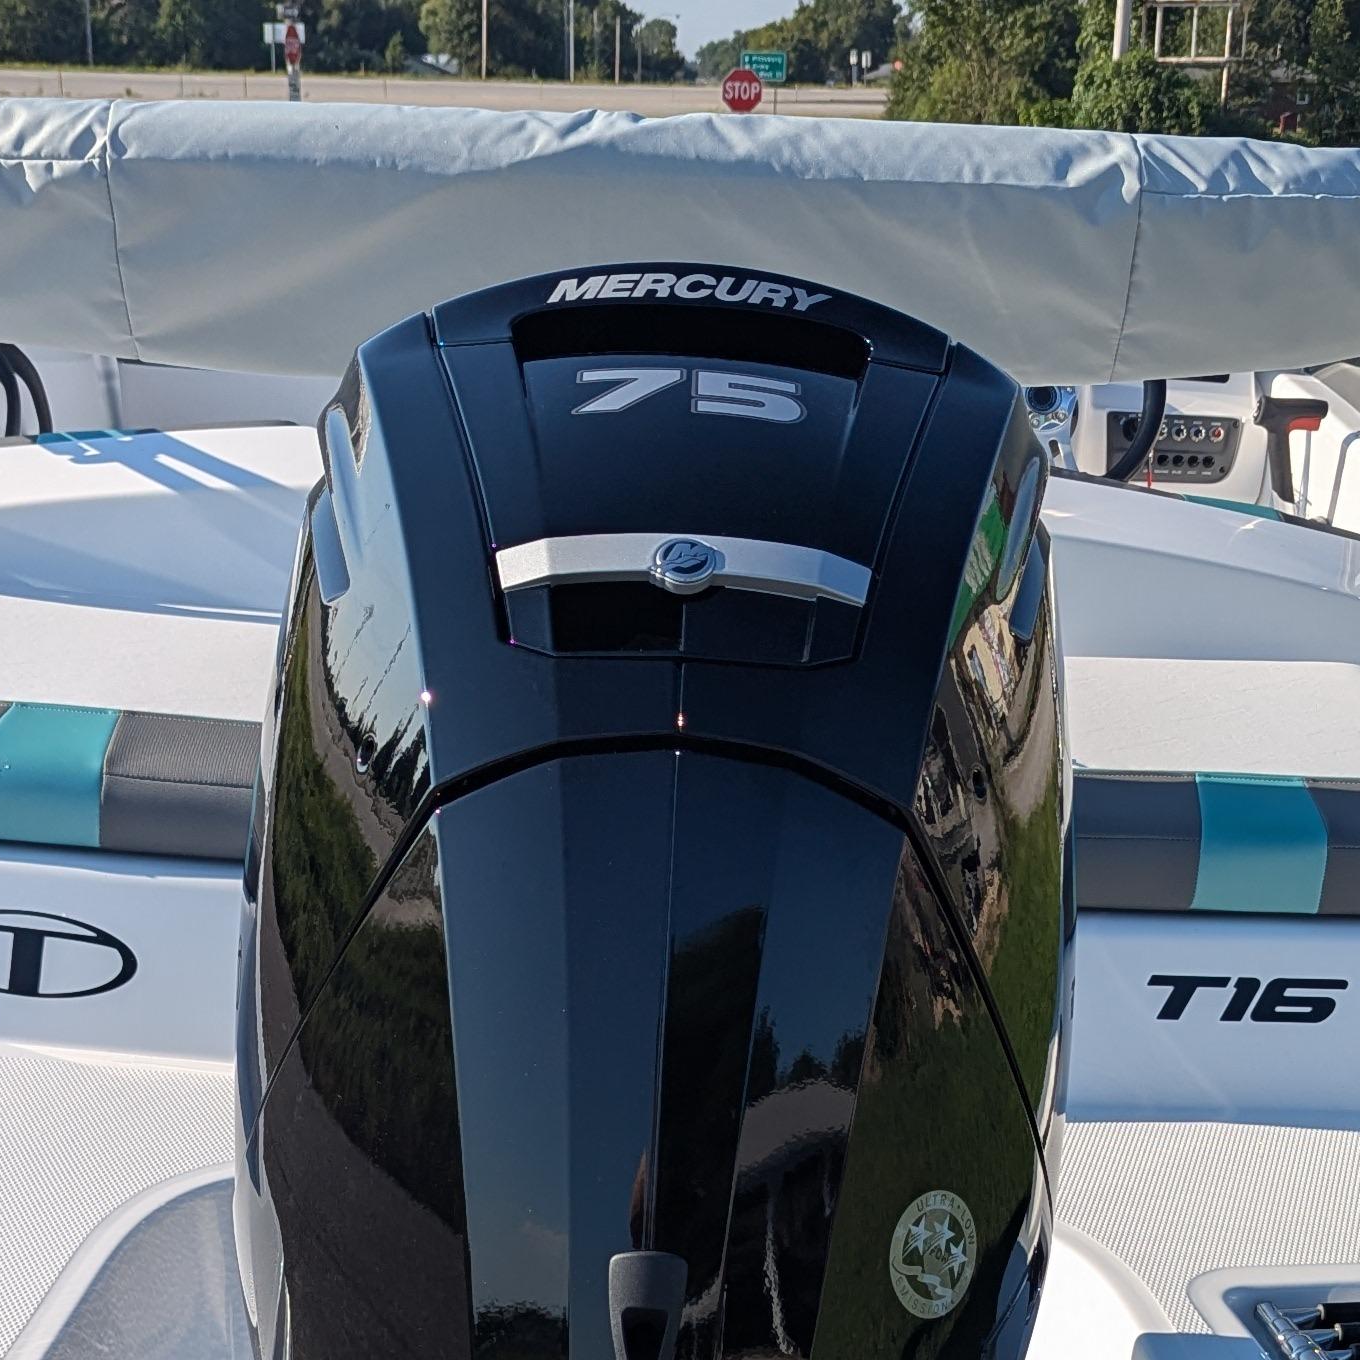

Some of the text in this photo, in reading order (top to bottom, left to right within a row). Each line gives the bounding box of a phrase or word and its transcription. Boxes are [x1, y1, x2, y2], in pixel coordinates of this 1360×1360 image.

[725, 80, 760, 101] STOP
[546, 273, 832, 312] MERCURY
[571, 367, 807, 424] 75
[1147, 974, 1349, 1024] T16
[916, 1193, 975, 1246] ULTRA LOW
